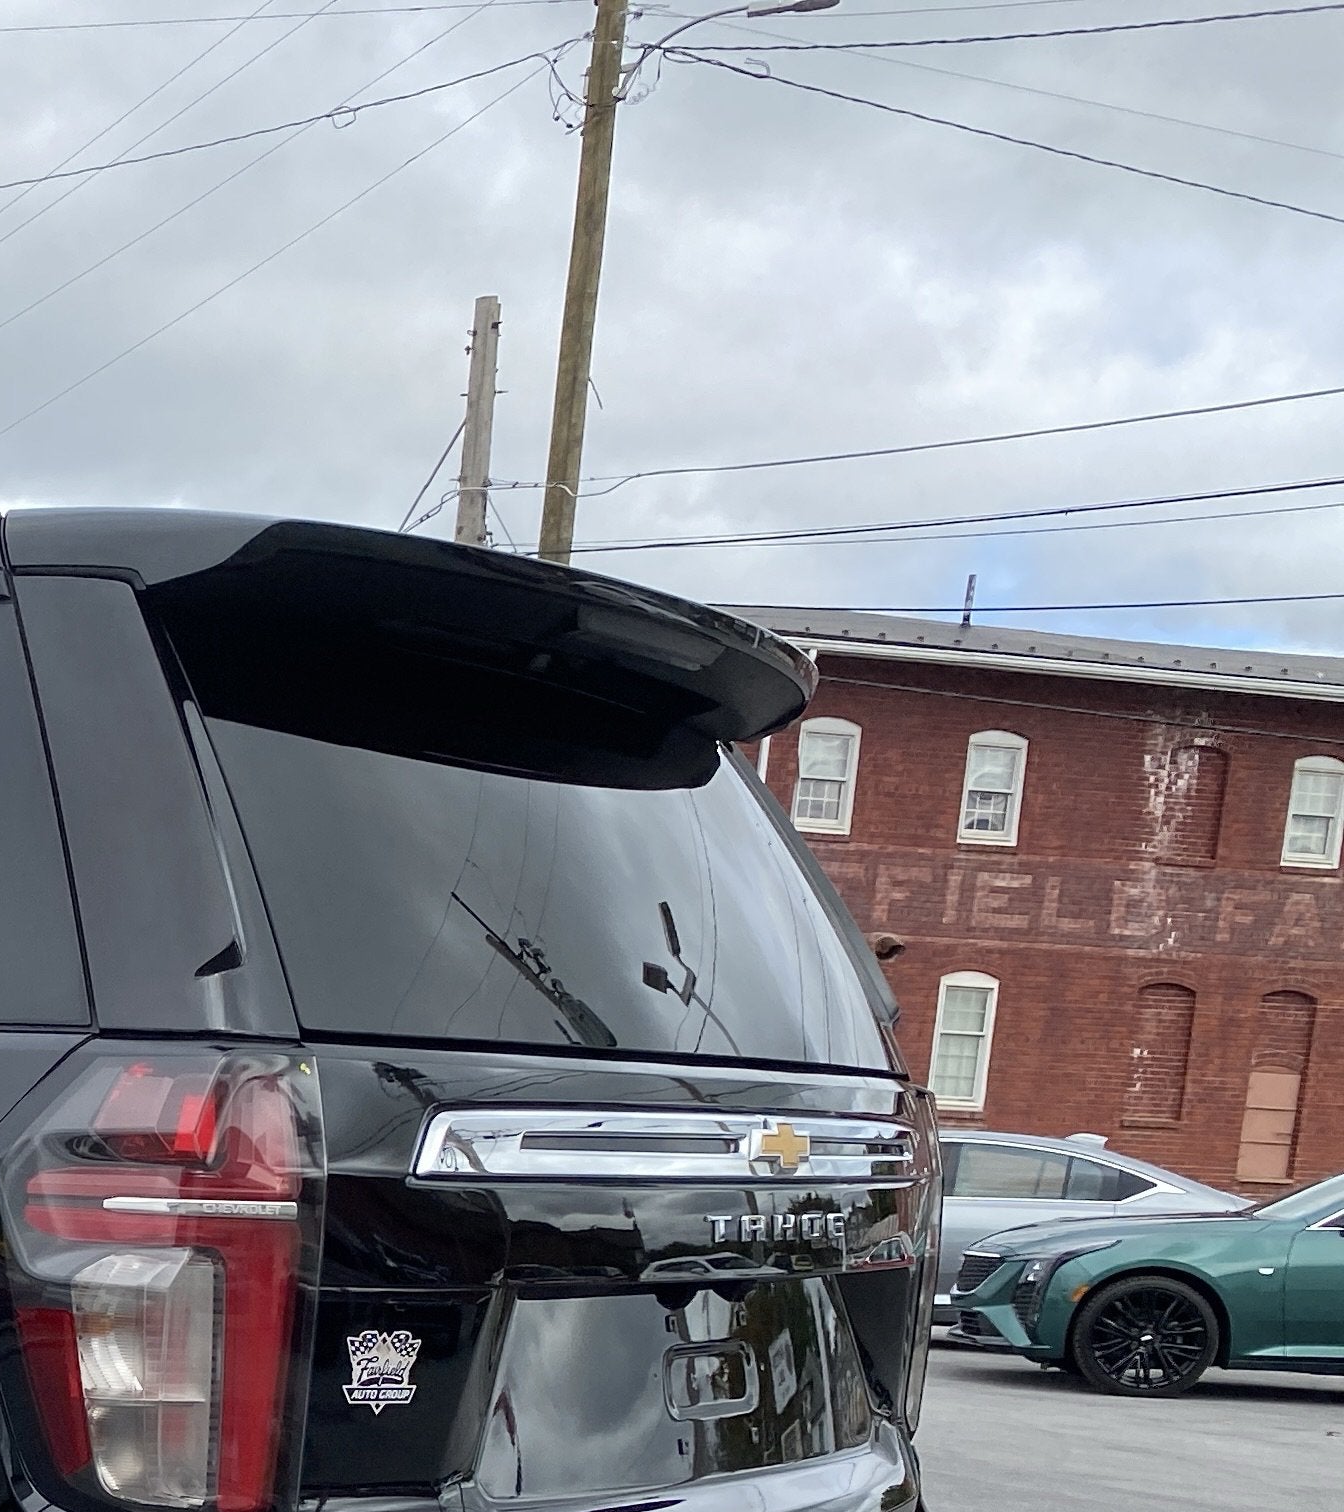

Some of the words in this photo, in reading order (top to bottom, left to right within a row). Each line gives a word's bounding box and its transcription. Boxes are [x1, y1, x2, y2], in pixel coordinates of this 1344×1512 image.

[202, 1203, 282, 1215] CHEVROLET
[704, 1212, 846, 1244] TAHOE
[356, 1356, 411, 1387] Fairfield
[351, 1389, 378, 1400] AUTO
[378, 1389, 411, 1400] GROUP
